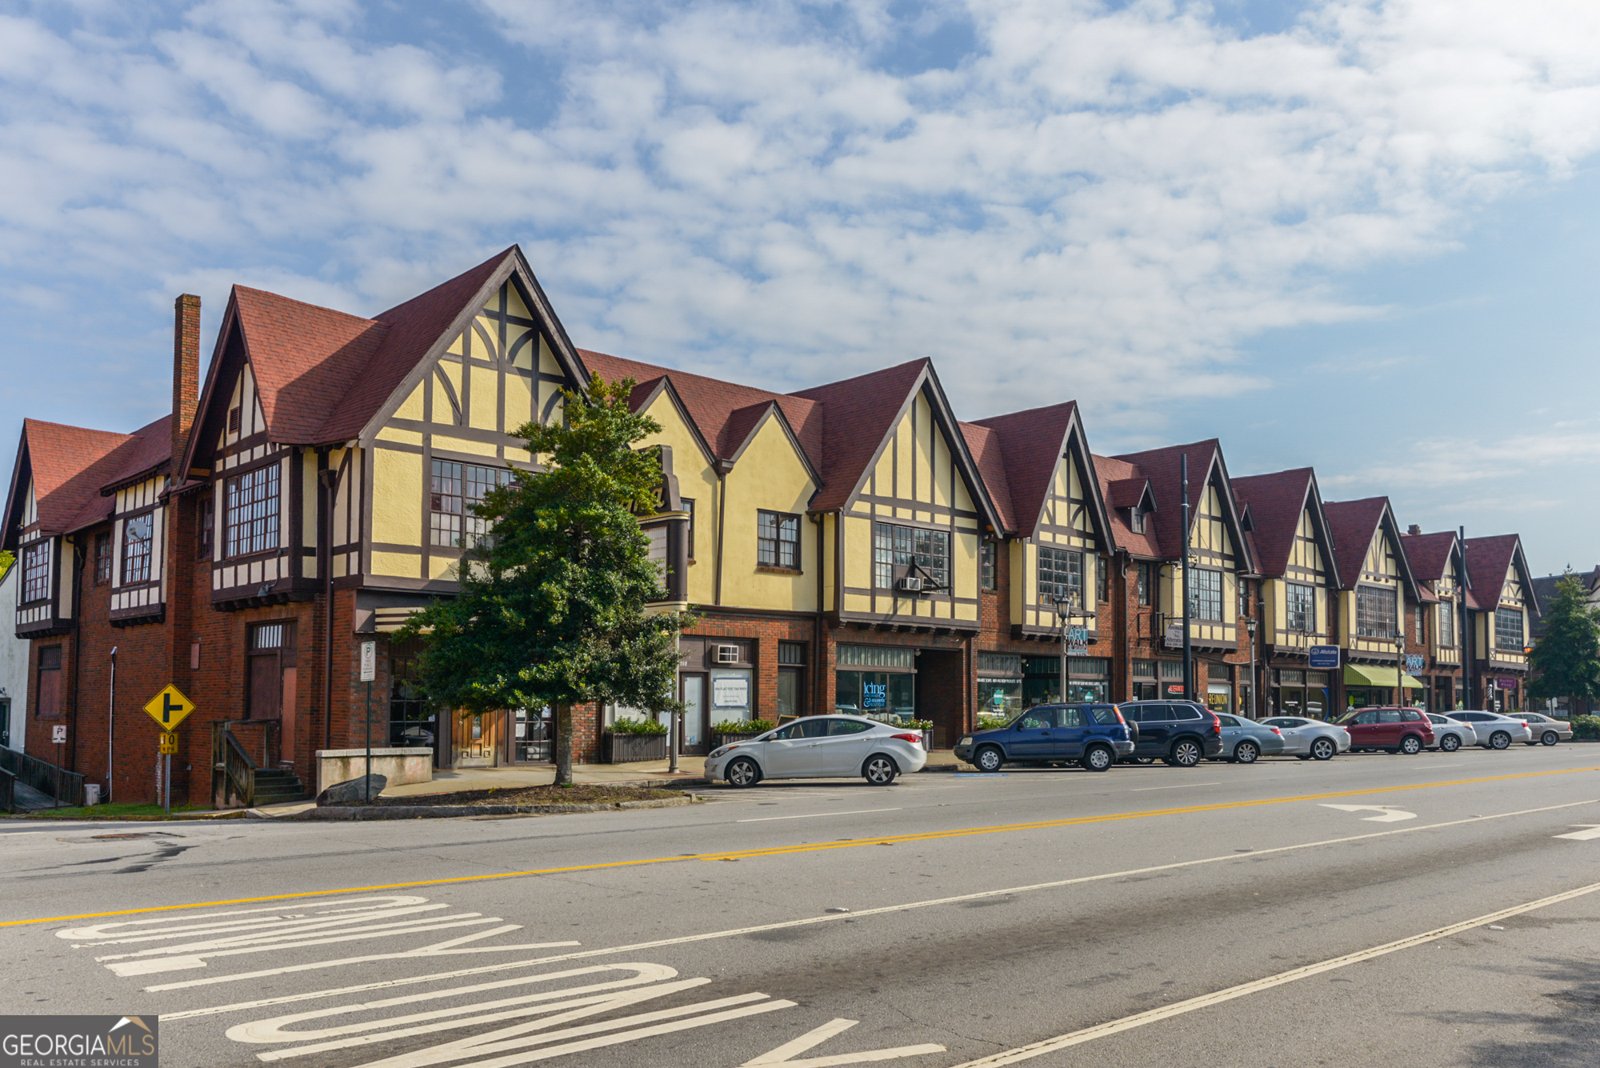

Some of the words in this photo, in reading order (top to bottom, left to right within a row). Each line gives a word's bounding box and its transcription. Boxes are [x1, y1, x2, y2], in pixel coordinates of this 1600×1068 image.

[1068, 628, 1088, 641] ART
[1208, 693, 1228, 705] REUNION
[162, 734, 175, 745] 10
